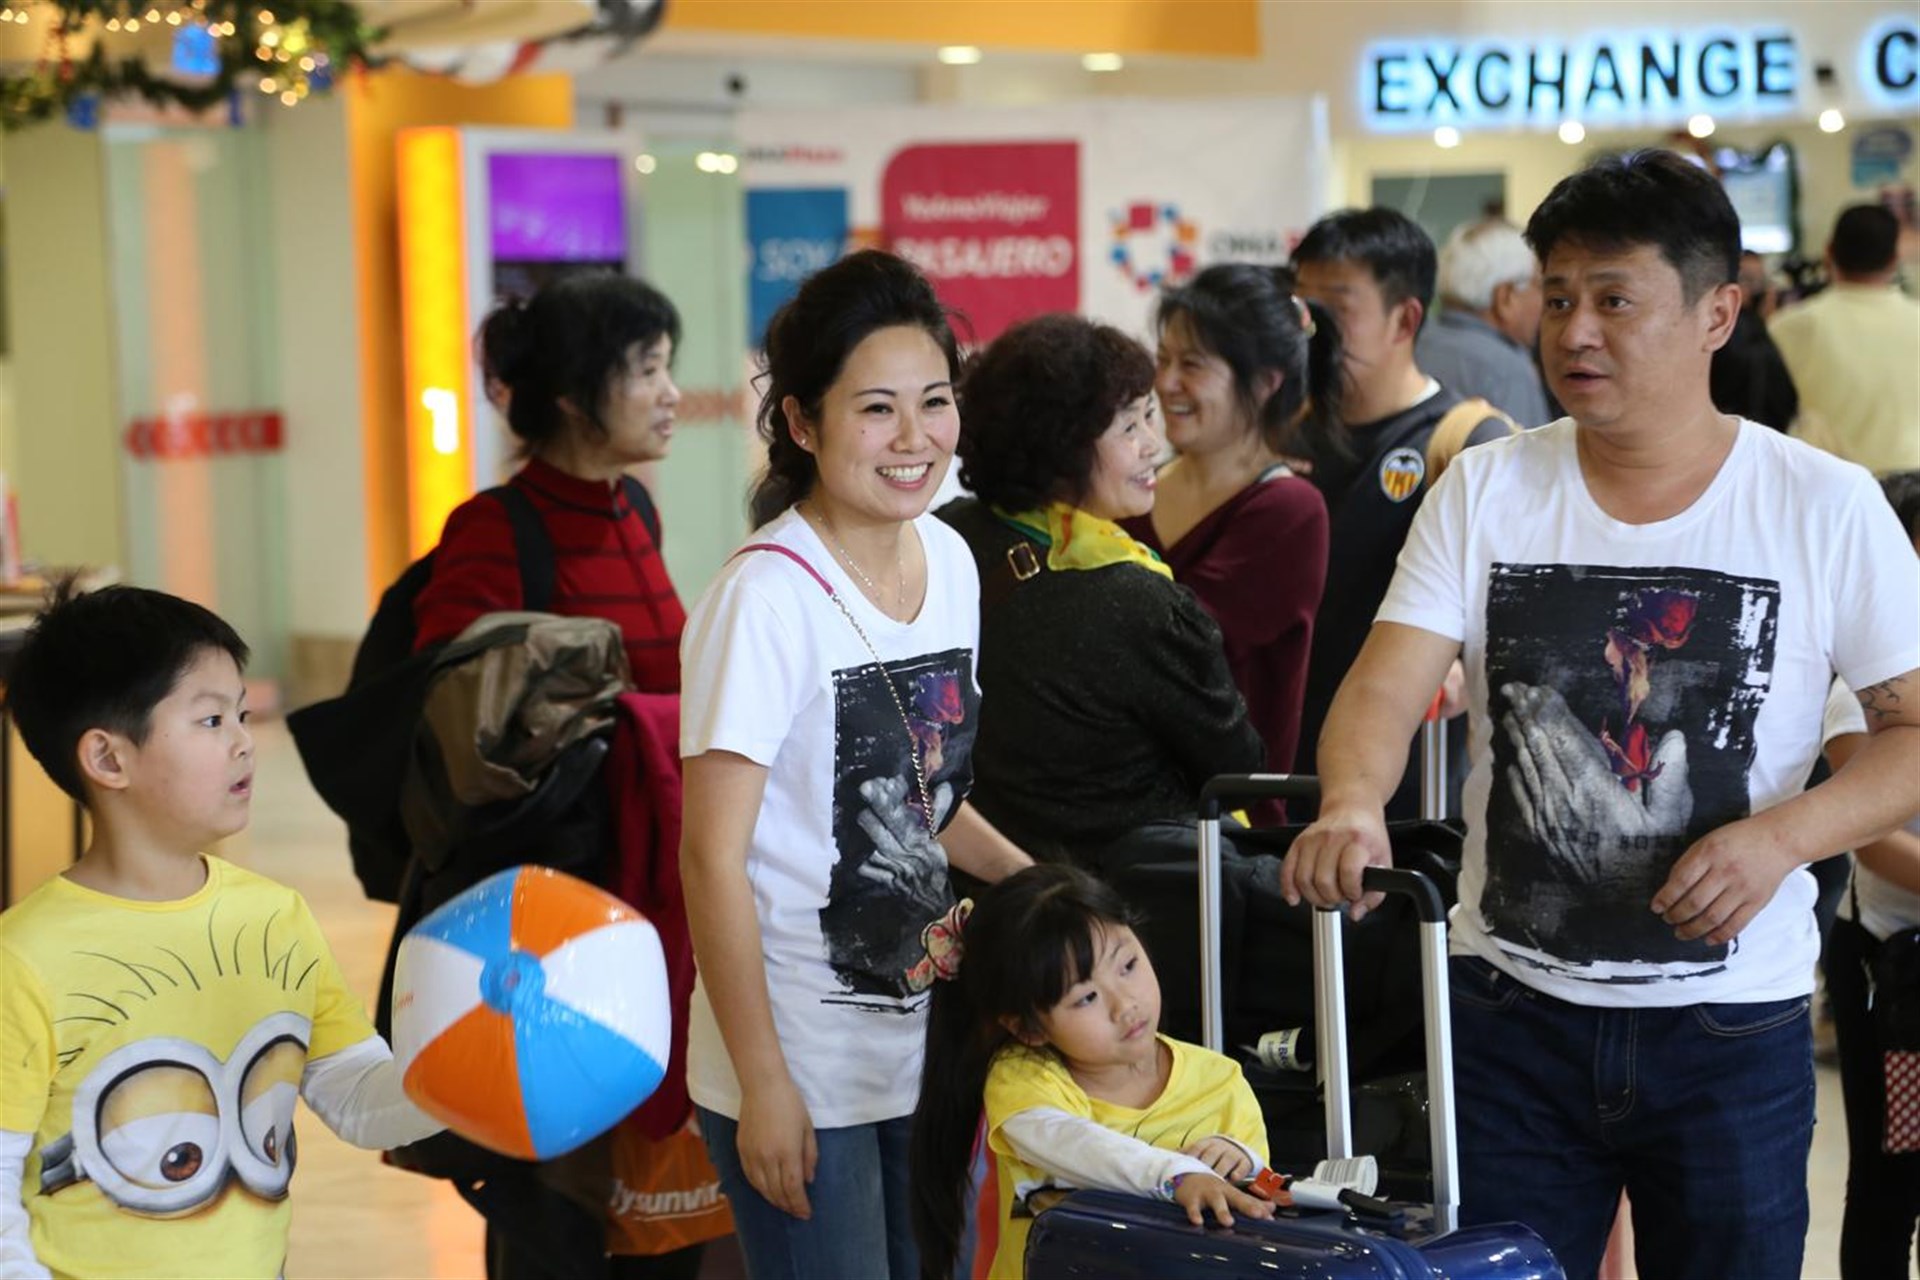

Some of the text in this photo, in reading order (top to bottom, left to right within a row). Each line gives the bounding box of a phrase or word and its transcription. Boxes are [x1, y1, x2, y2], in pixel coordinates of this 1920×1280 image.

[1375, 31, 1918, 114] EXCHANGE C
[421, 387, 457, 453] 1
